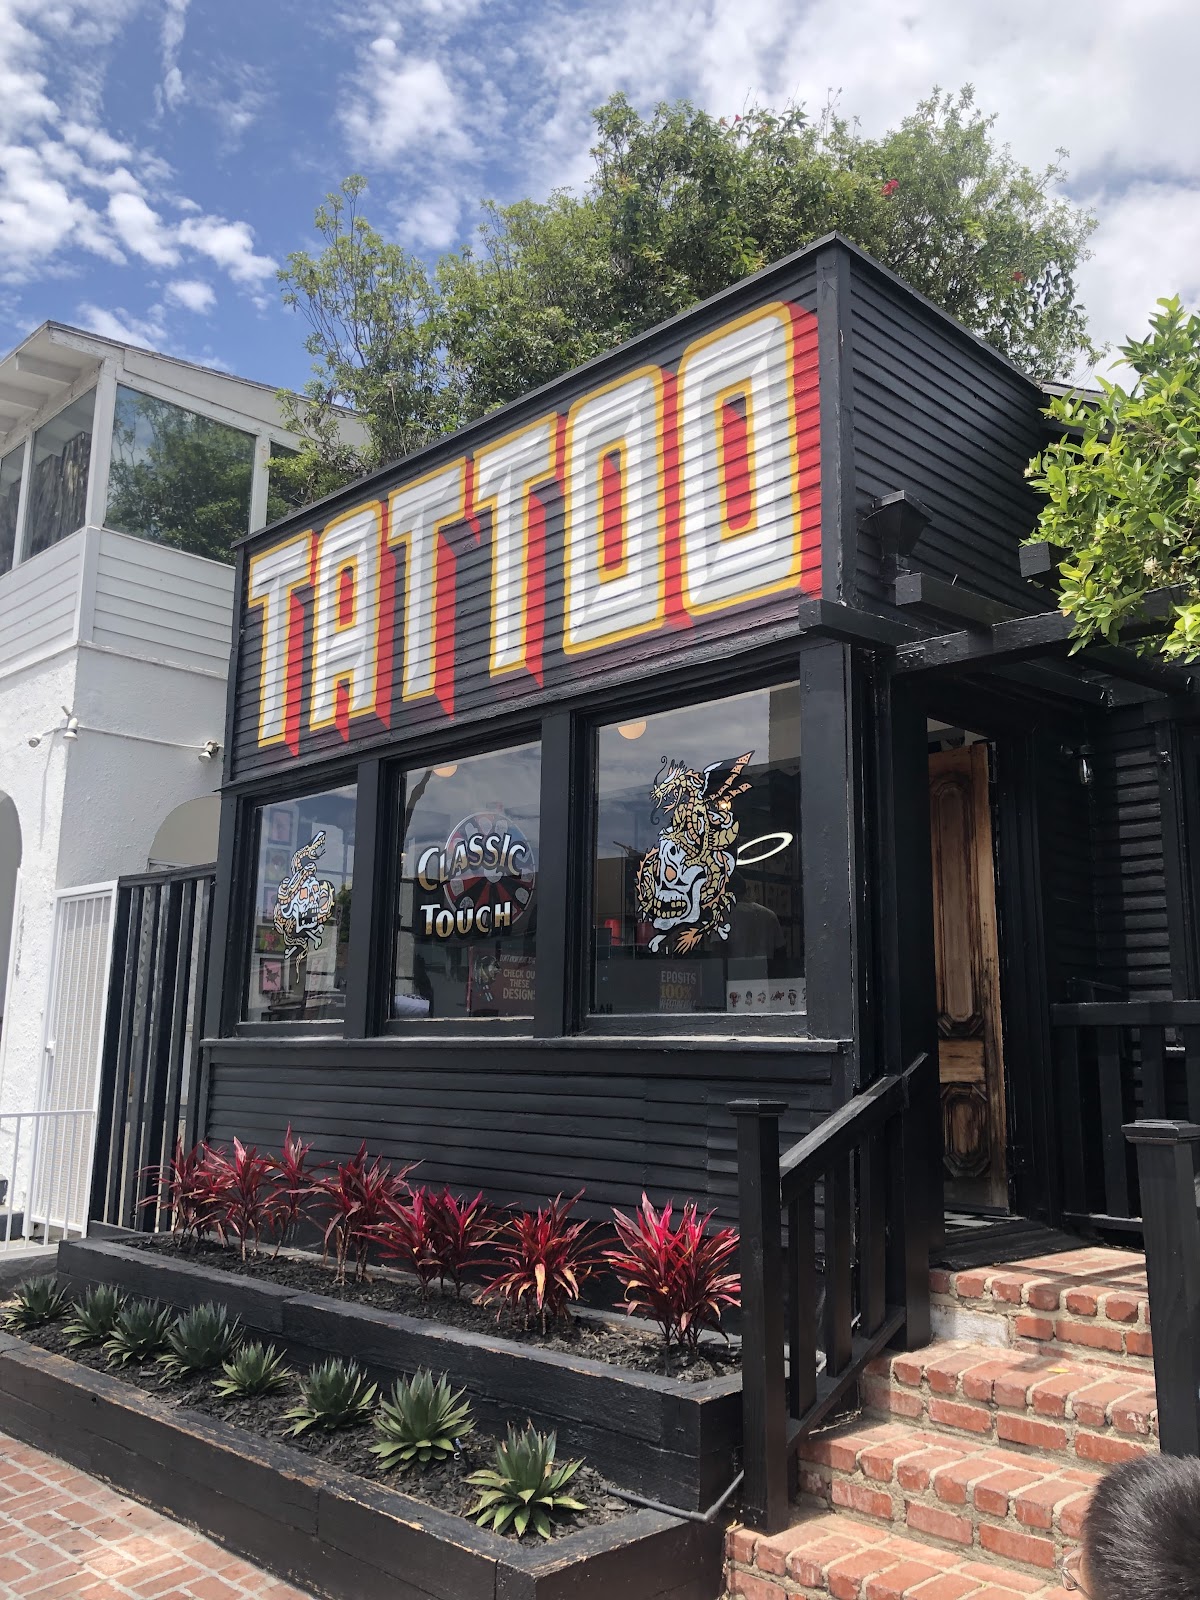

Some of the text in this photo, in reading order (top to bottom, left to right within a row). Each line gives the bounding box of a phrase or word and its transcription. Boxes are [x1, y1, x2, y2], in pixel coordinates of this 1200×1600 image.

[248, 301, 822, 757] TATTOO
[420, 901, 512, 938] TOUCH
[503, 969, 536, 980] CHECK OU
[509, 979, 530, 988] THESE
